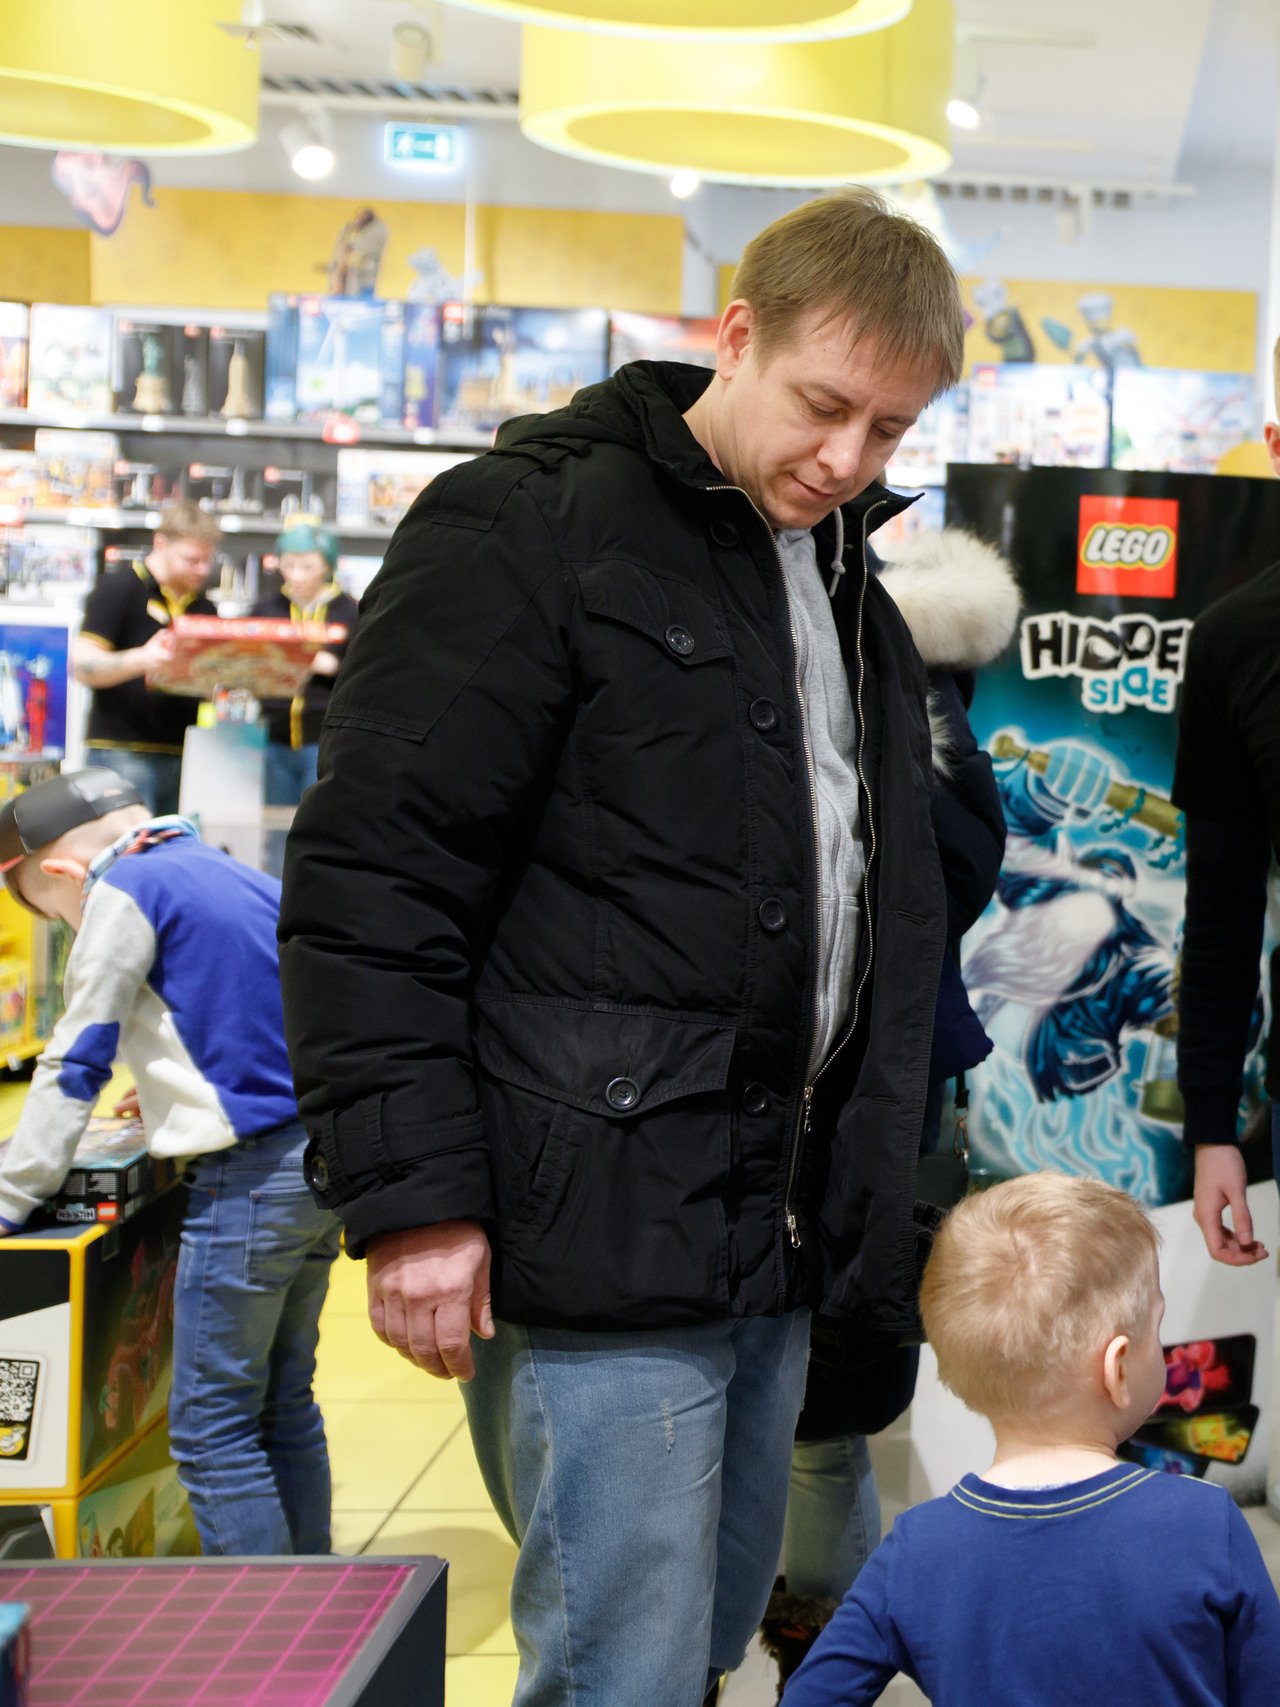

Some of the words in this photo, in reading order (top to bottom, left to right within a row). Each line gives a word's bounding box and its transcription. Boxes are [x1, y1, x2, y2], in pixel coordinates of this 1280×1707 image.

[1082, 525, 1172, 568] LEGO
[1025, 616, 1189, 676] HIDDE
[1087, 666, 1169, 706] SIDE
